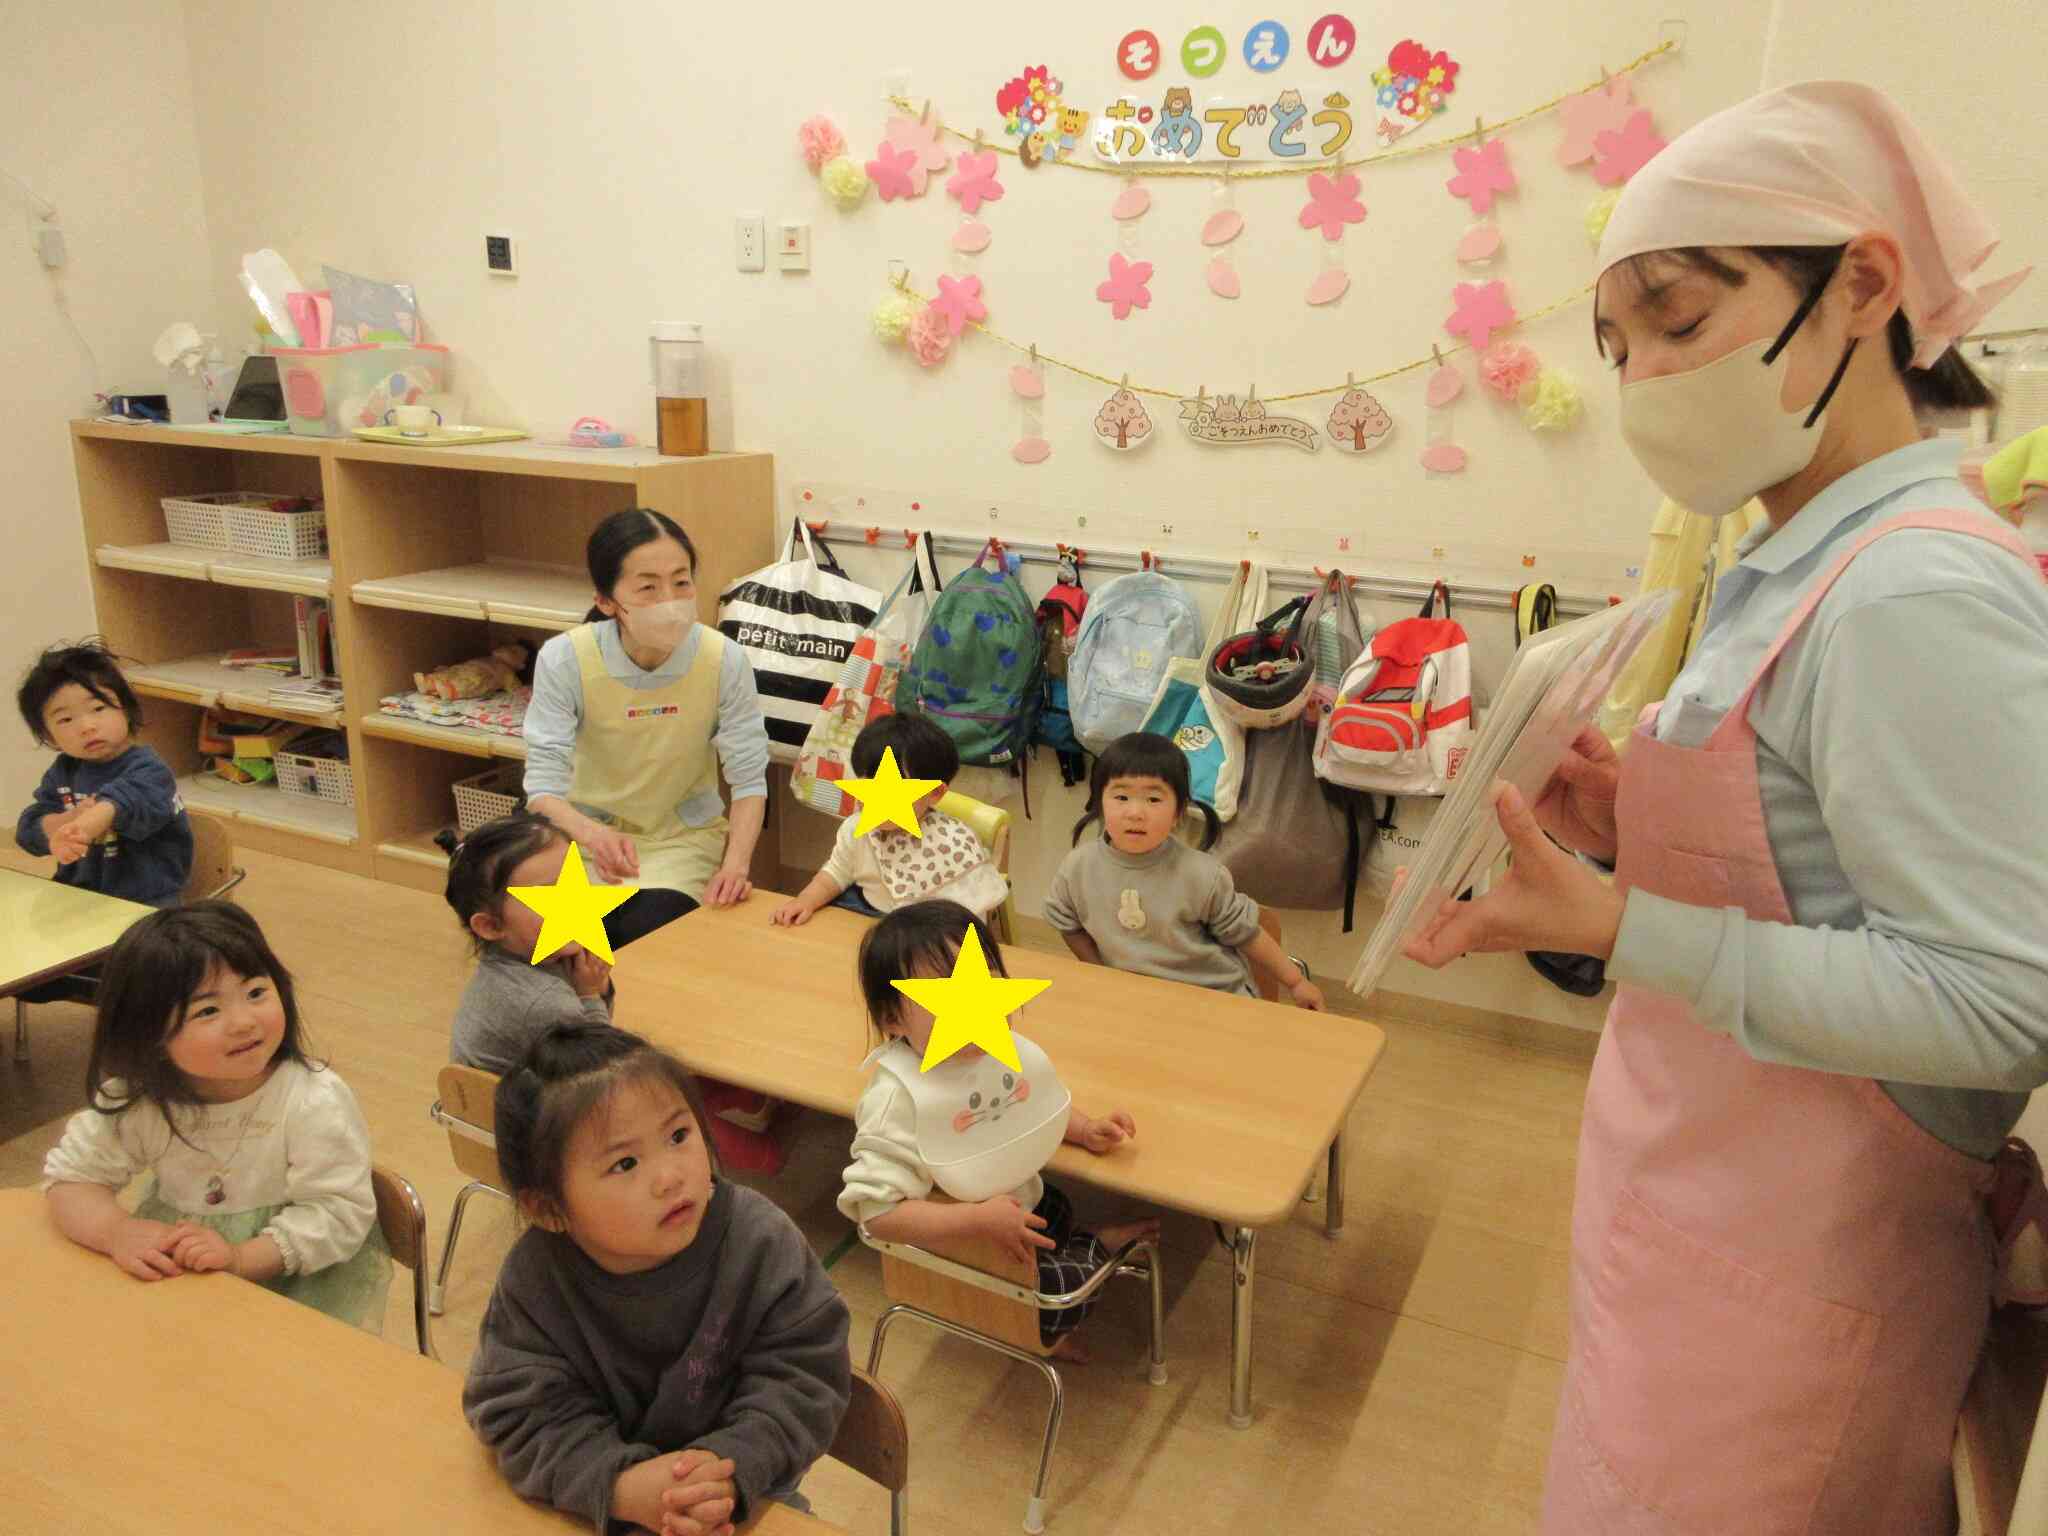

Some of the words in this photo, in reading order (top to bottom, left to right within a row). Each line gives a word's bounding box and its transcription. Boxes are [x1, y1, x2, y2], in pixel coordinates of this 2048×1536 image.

[1125, 24, 1348, 72] そつえん
[1096, 89, 1352, 158] おめでとう
[737, 626, 786, 649] petit
[797, 639, 845, 658] main
